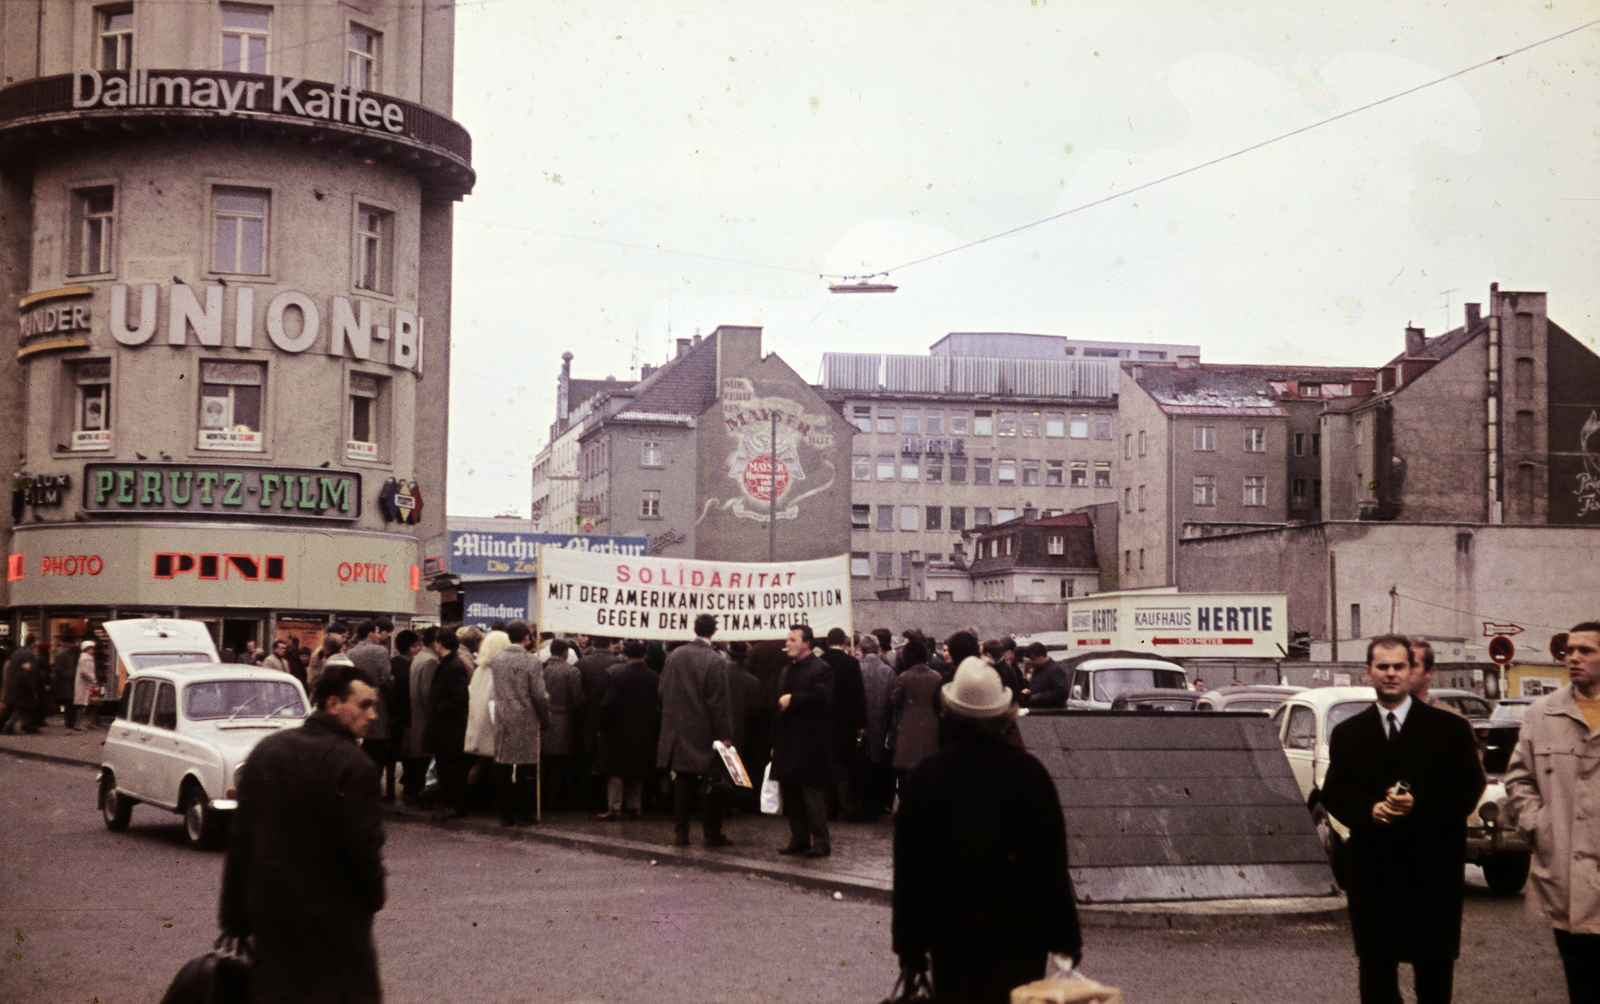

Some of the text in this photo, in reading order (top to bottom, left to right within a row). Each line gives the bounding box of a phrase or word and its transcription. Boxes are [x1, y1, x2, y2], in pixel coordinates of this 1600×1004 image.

[72, 68, 404, 132] Dallmayr Kaffee
[110, 283, 424, 374] UNION-B
[95, 469, 352, 512] PERUTZ-FILM
[41, 555, 103, 576] PHOTO
[153, 552, 285, 582] PINI
[337, 561, 388, 584] OPTIK
[487, 560, 510, 572] Die
[548, 583, 842, 610] MIT DER AMERIKANISCHEN OPPOSITION
[467, 602, 525, 619] Münchner
[597, 608, 650, 628] GEGEN
[659, 612, 688, 630] DEN
[1092, 608, 1117, 632] HERTIE
[1134, 607, 1272, 631] KAUFHAUS HERTIE
